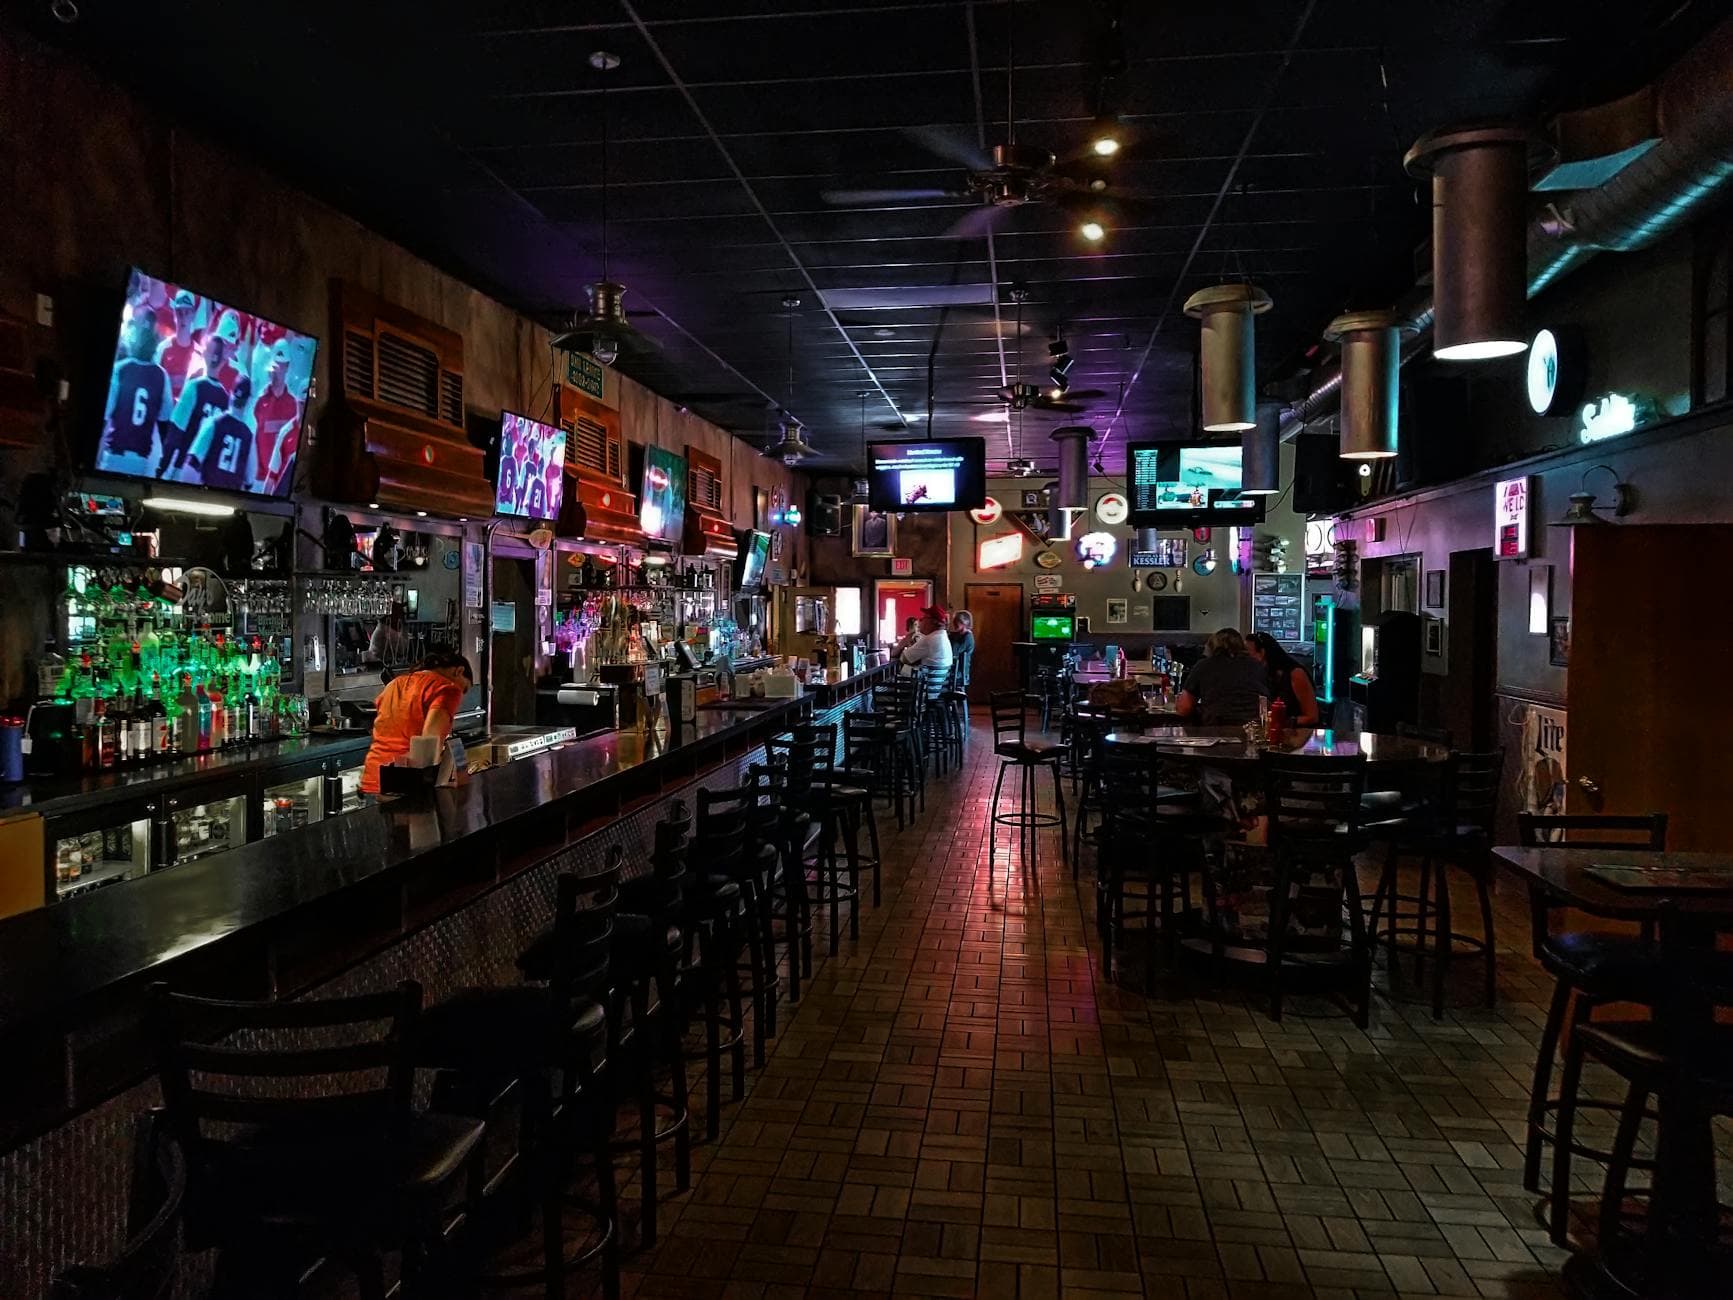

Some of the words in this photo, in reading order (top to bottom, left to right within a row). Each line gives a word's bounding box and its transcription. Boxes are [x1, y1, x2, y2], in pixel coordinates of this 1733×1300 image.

[131, 387, 149, 426] 6
[218, 434, 241, 473] 21
[505, 470, 512, 489] 6
[533, 488, 542, 508] 21
[1133, 557, 1170, 566] KESSLER
